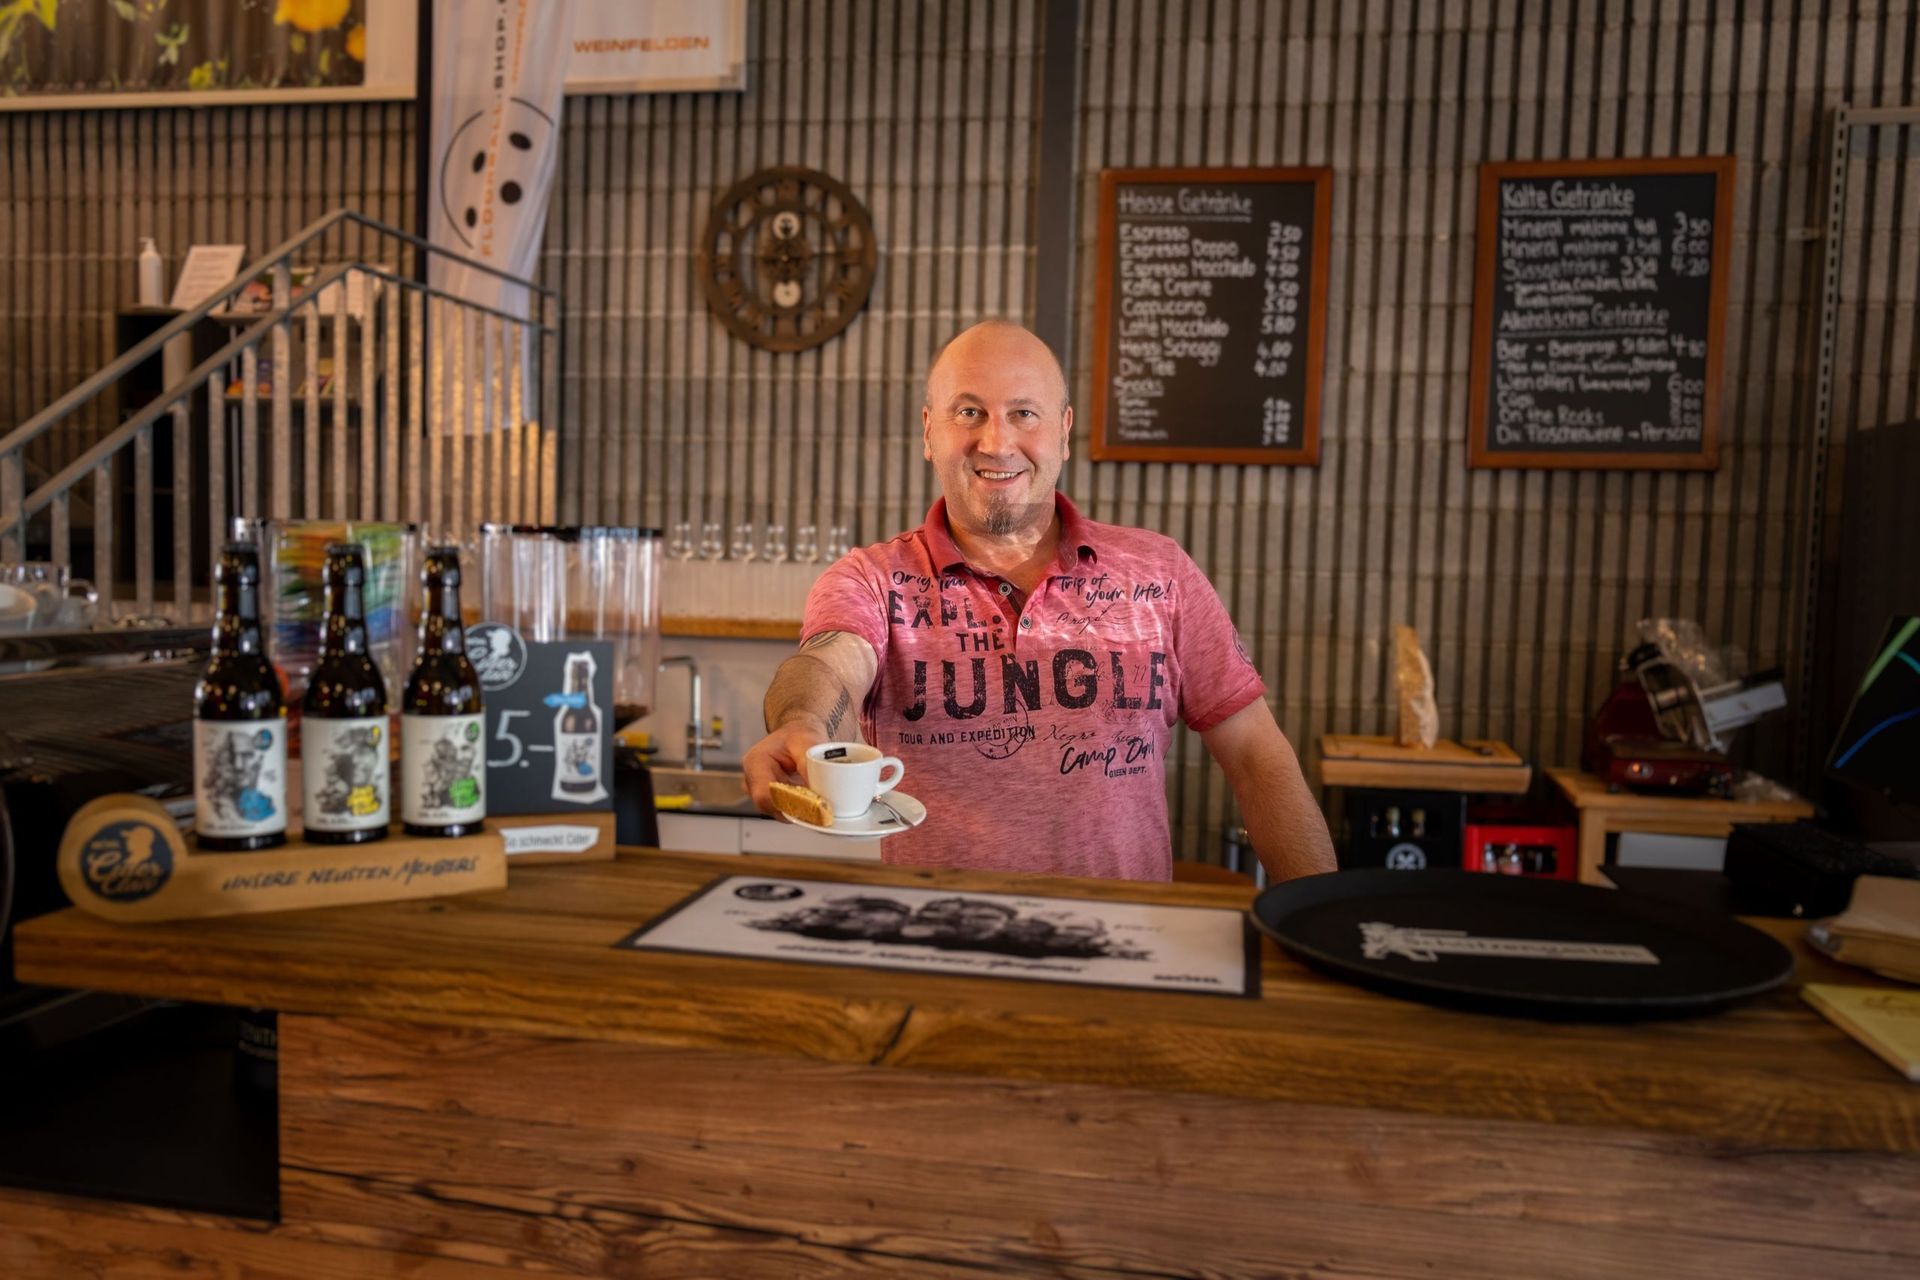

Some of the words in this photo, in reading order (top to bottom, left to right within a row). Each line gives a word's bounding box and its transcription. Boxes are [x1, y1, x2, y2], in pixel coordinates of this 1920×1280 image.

[573, 36, 709, 53] WEINFELDEN
[1178, 187, 1253, 214] Getränke
[1501, 182, 1549, 209] Kalte
[1550, 180, 1635, 209] Getränke
[1119, 223, 1190, 243] Espresso
[1502, 217, 1563, 239] Mineral
[1119, 243, 1191, 261] Espresso
[1192, 239, 1239, 259] Doppio
[1502, 239, 1559, 257] Mineral
[1120, 260, 1189, 278] Espresso
[1121, 297, 1207, 319] Cappuccino
[1590, 303, 1669, 327] Getränke
[1118, 318, 1159, 337] Latte
[1496, 339, 1528, 361] Bier
[1151, 357, 1176, 377] Tee
[1535, 373, 1576, 394] offen
[1527, 405, 1554, 424] the
[1557, 404, 1604, 425] Rocks
[892, 571, 934, 593] Orig.
[1056, 575, 1086, 596] Trip
[1091, 573, 1109, 588] of
[1086, 587, 1125, 608] your
[888, 590, 1002, 629] EXPL.
[956, 628, 1005, 652] THE
[902, 648, 1167, 721] JUNGLE
[899, 732, 923, 745] TOUR
[929, 732, 955, 744] AND
[1060, 747, 1116, 776] Camp
[223, 871, 300, 892] UNSERE
[306, 866, 393, 885] NEUSTEN
